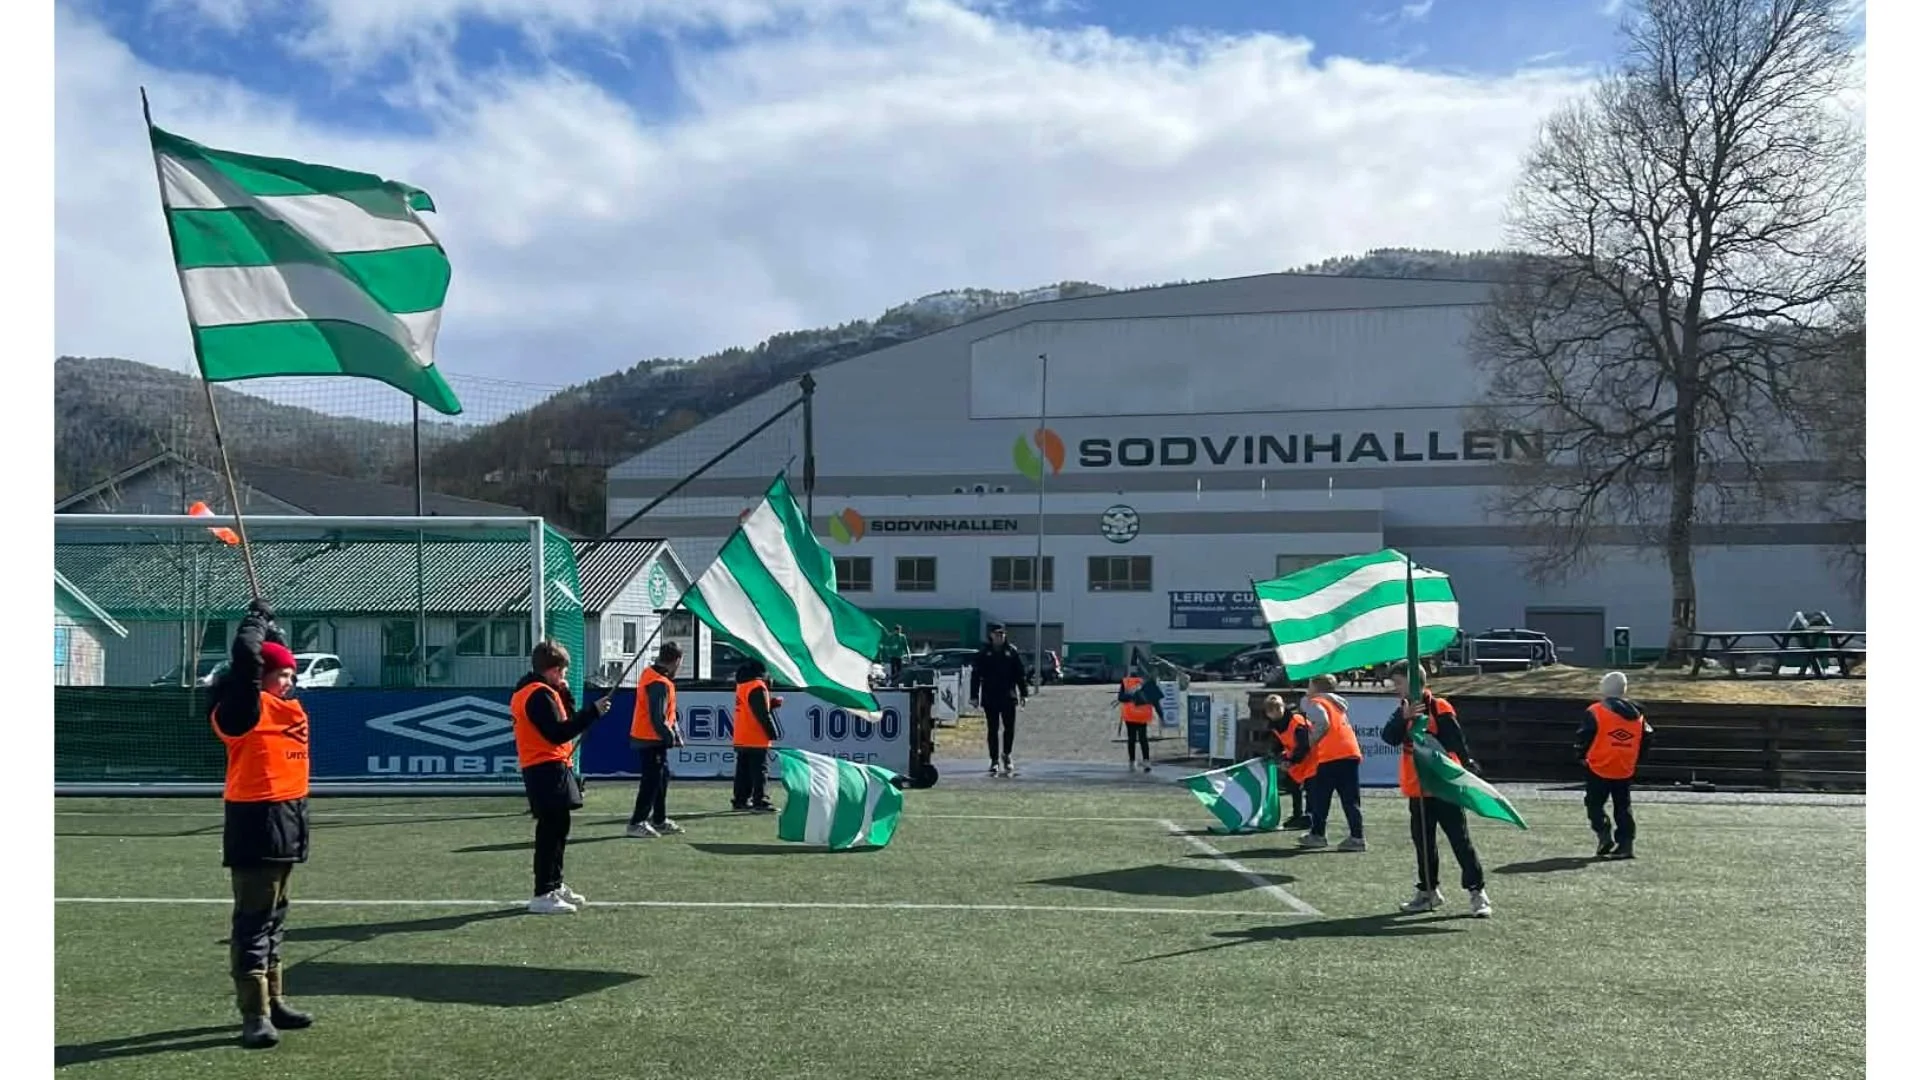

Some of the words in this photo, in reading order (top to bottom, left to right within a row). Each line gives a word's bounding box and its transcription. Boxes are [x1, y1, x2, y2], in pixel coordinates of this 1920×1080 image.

[1079, 431, 1543, 468] SODVINHALLEN
[871, 519, 1018, 532] SODVINHALLEN
[1173, 592, 1226, 603] LERØY
[1232, 592, 1258, 603] CU
[807, 706, 902, 741] 1000
[367, 755, 522, 773] UMBR
[679, 750, 735, 764] bare
